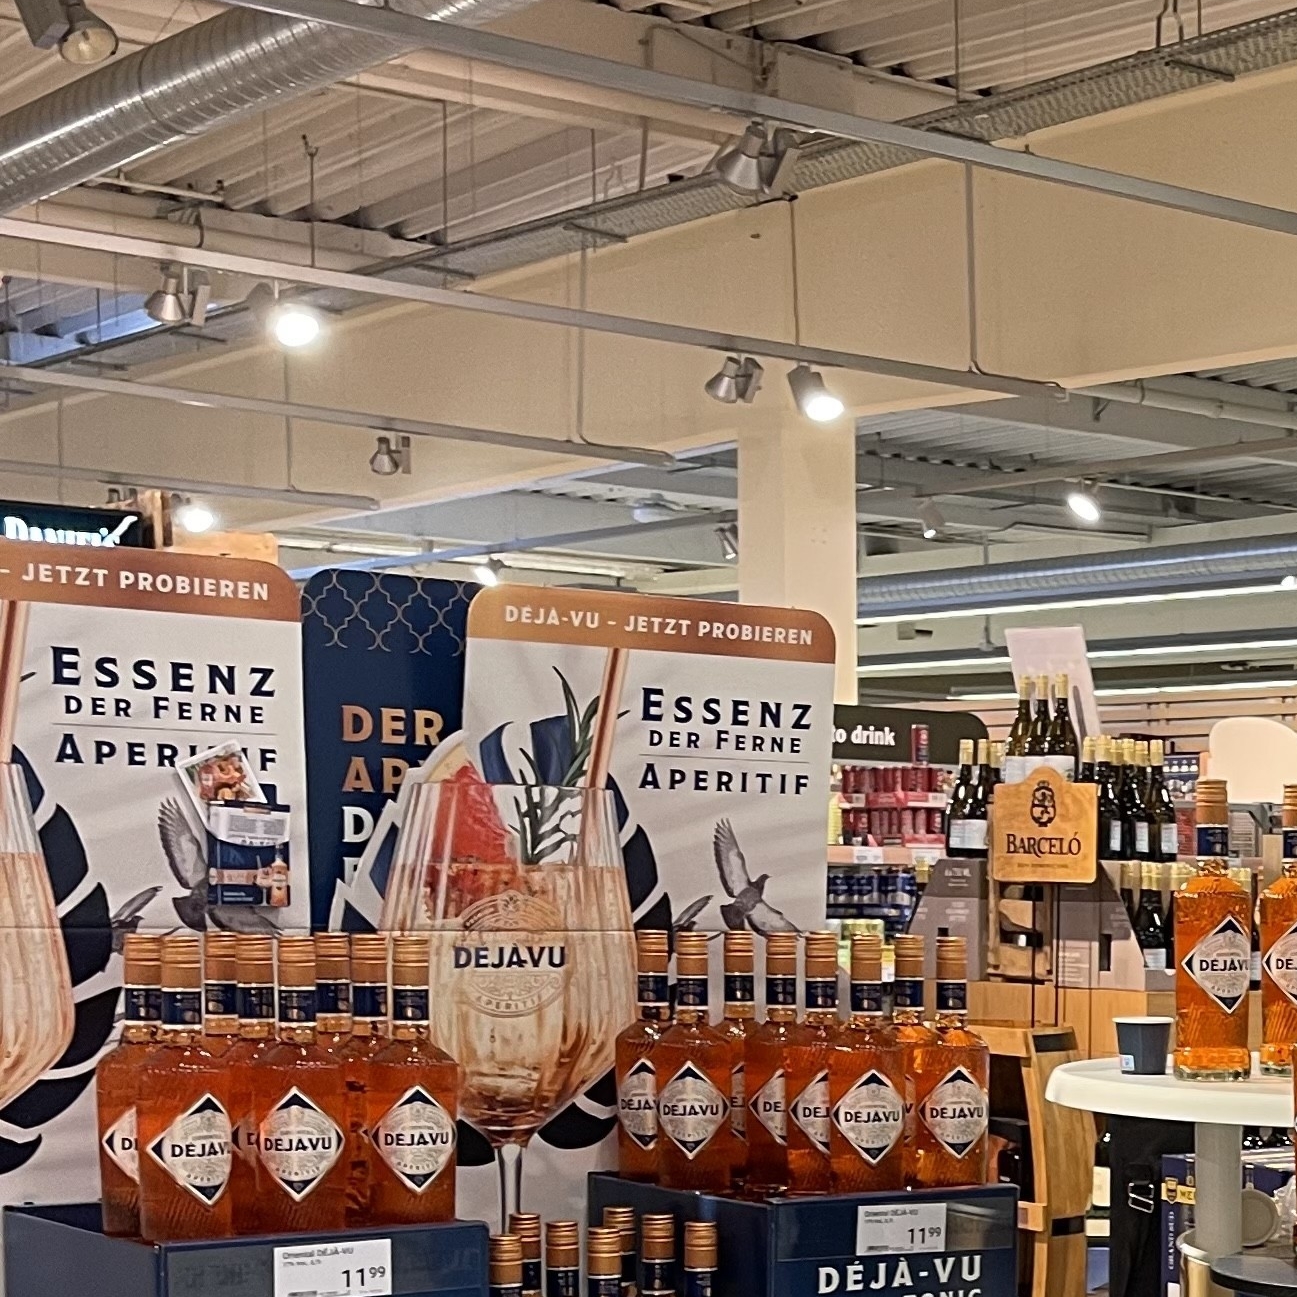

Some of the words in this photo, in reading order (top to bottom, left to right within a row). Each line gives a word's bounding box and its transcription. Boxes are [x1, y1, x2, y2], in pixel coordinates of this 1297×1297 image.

[22, 563, 109, 586] JETZT
[119, 570, 269, 601] PROBIEREN
[623, 615, 691, 637] JETZT
[697, 620, 813, 646] PROBIEREN
[50, 645, 276, 698] ESSENZ
[64, 695, 132, 718] DER
[153, 697, 264, 724] FERNE
[640, 686, 813, 730] ESSENZ
[341, 705, 444, 746] DER
[649, 729, 700, 749] DER
[715, 730, 803, 754] FERNE
[851, 725, 896, 746] drink
[638, 763, 810, 796] APERITIF
[1006, 832, 1082, 858] BARCELÓ
[818, 1254, 982, 1295] DÉJÀ-VU
